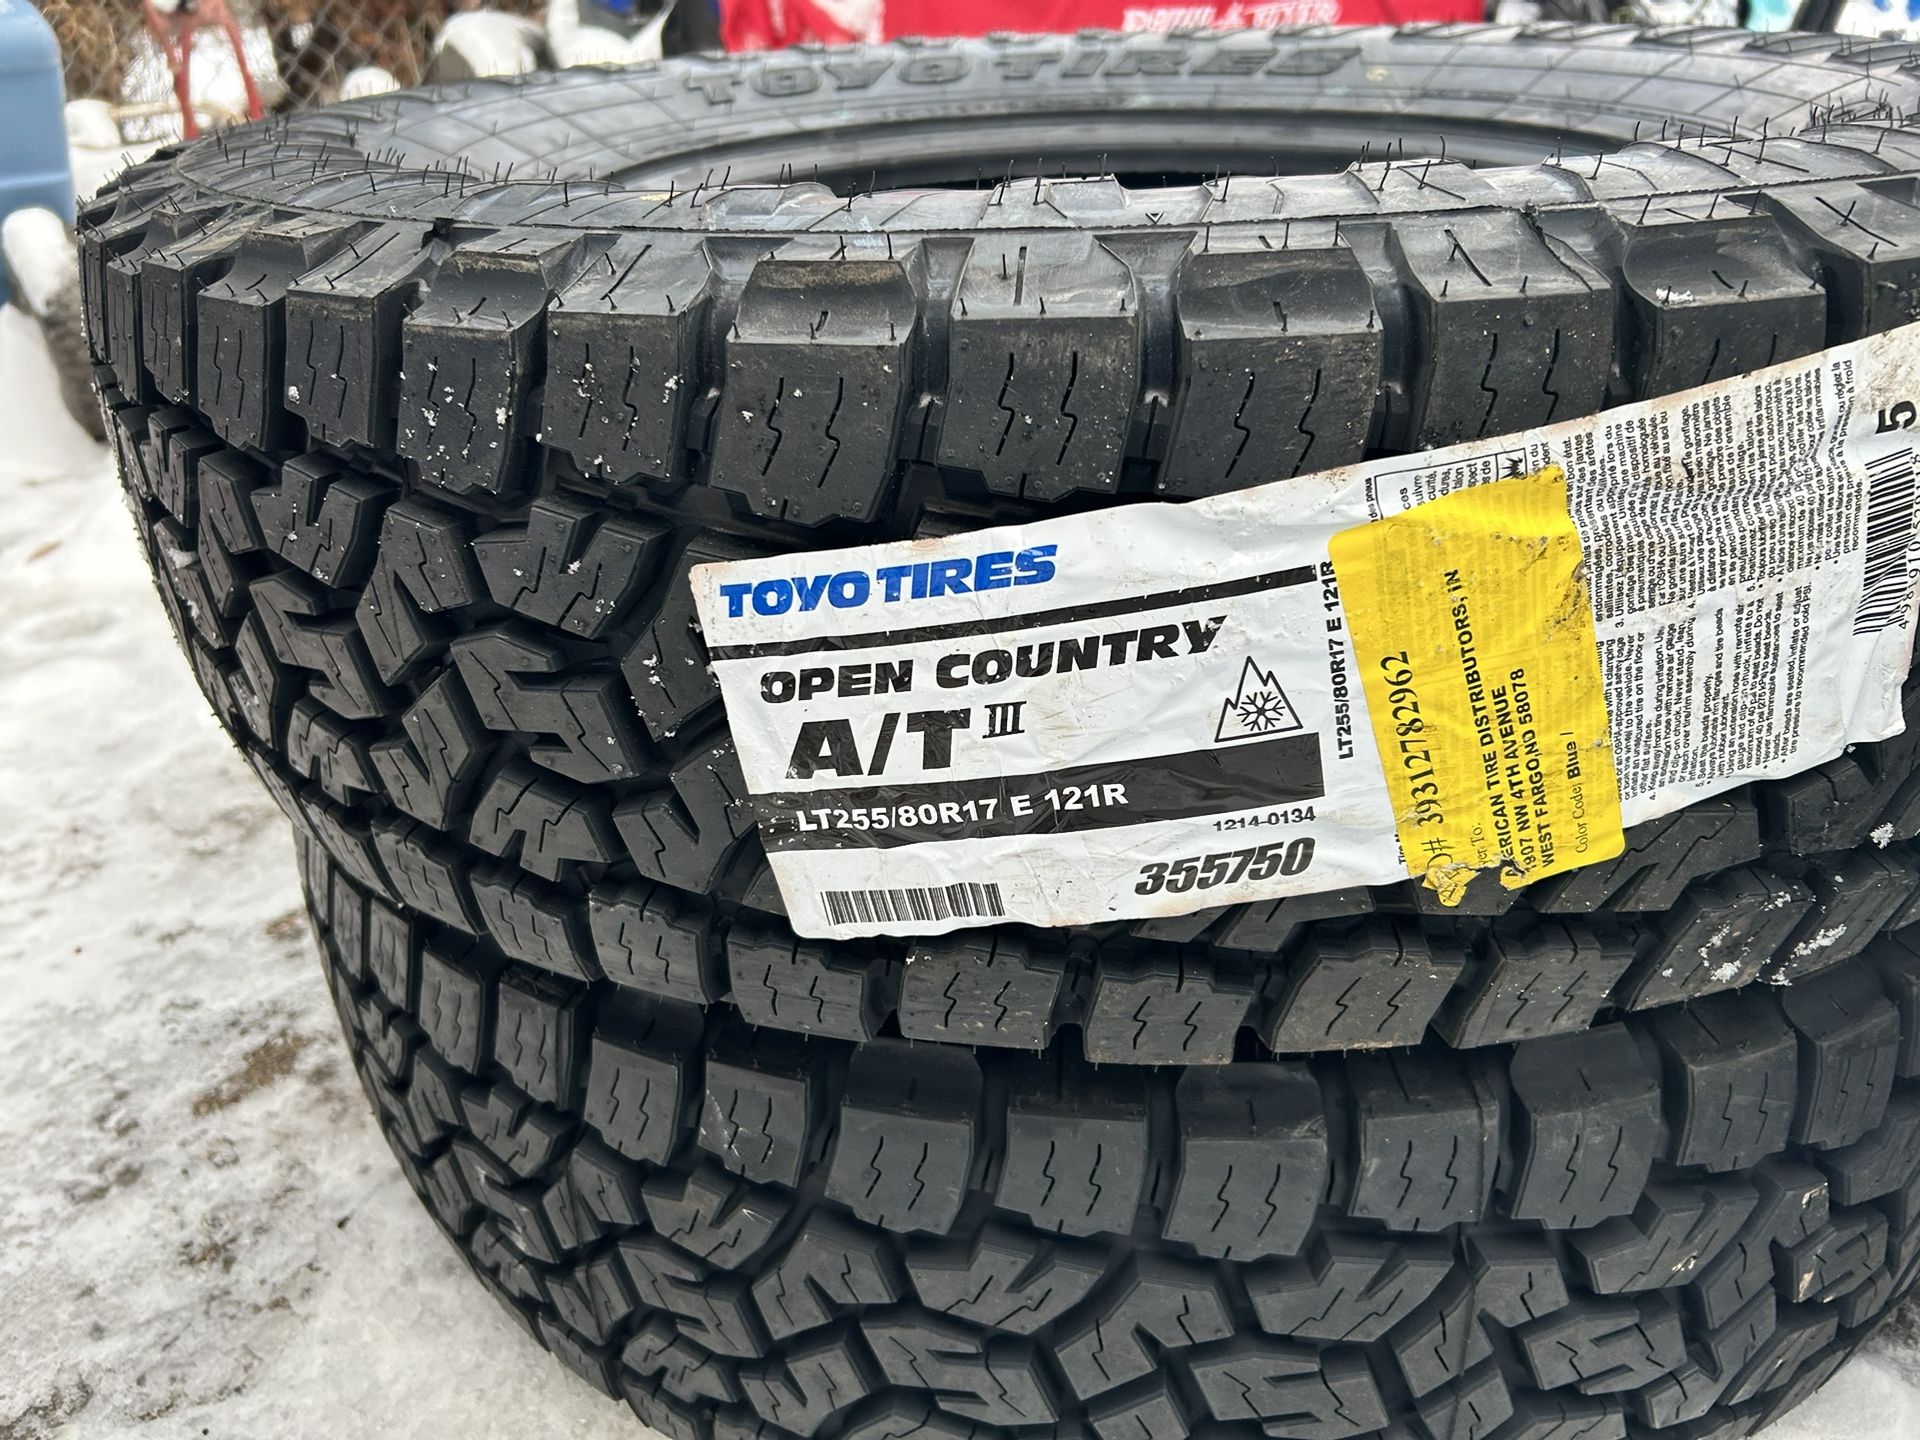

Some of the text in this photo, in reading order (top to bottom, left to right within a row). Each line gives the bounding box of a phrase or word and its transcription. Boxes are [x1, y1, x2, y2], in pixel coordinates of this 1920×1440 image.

[683, 46, 1362, 105] TOYO TIRES
[1875, 400, 1917, 435] 5
[720, 544, 1057, 618] TOYO TIRES
[1755, 597, 1763, 612] not
[1714, 607, 1724, 636] beads
[1754, 614, 1763, 627] Do
[1665, 623, 1676, 650] gauge
[1715, 637, 1723, 651] tire
[760, 615, 1227, 703] OPEN COUNTRY
[1320, 560, 1354, 760] LT255/80R17 E 121R
[1603, 638, 1615, 680] clamping
[1665, 653, 1673, 663] air
[1674, 644, 1684, 675] stand,
[1714, 652, 1722, 668] and
[1622, 634, 1634, 728] to the vehicle. Never
[1665, 665, 1674, 696] remote
[1712, 670, 1722, 700] flanges
[1729, 616, 1743, 735] extension hose with remote
[1736, 609, 1753, 770] gauge and to
[1749, 680, 1757, 690] to
[1782, 707, 1791, 735] beads
[1793, 617, 1799, 626] or
[1789, 603, 1809, 753] tire pressure to recommended cold
[1601, 688, 1613, 708] with
[1632, 632, 1644, 757] unsecured tire on the floor or
[1653, 684, 1665, 711] during
[1663, 698, 1672, 716] with
[1673, 678, 1683, 705] Never
[1680, 616, 1695, 773] reach over tire/rim assembly during
[1444, 569, 1518, 877] AERICAN TIRE DISTRIBUTORS, IN
[1610, 686, 1625, 754] OSHA-approved
[1653, 713, 1662, 727] tire
[1697, 673, 1713, 779] Seat beads properly.
[1748, 705, 1755, 716] 40
[1754, 661, 1768, 765] exceed 40 to
[785, 700, 1026, 778] A/T III
[1380, 651, 1443, 827] 39312782962
[1652, 728, 1661, 748] from
[1663, 718, 1671, 739] hose
[1566, 741, 1581, 779] Blue
[1652, 749, 1662, 769] away
[1670, 738, 1680, 768] clip-on
[1717, 733, 1726, 758] rubber
[1745, 728, 1754, 768] maximum
[1762, 738, 1770, 763] Never
[1492, 685, 1537, 873] 1907 NW 4TH AVENUE
[1510, 668, 1554, 867] WEST FARGO,ND 58078
[1639, 773, 1647, 793] other
[796, 782, 1128, 834] LT255/80R17 E 121R
[1213, 806, 1316, 831] 1214-0134
[1576, 822, 1588, 853] Color
[1134, 836, 1316, 895] 355750
